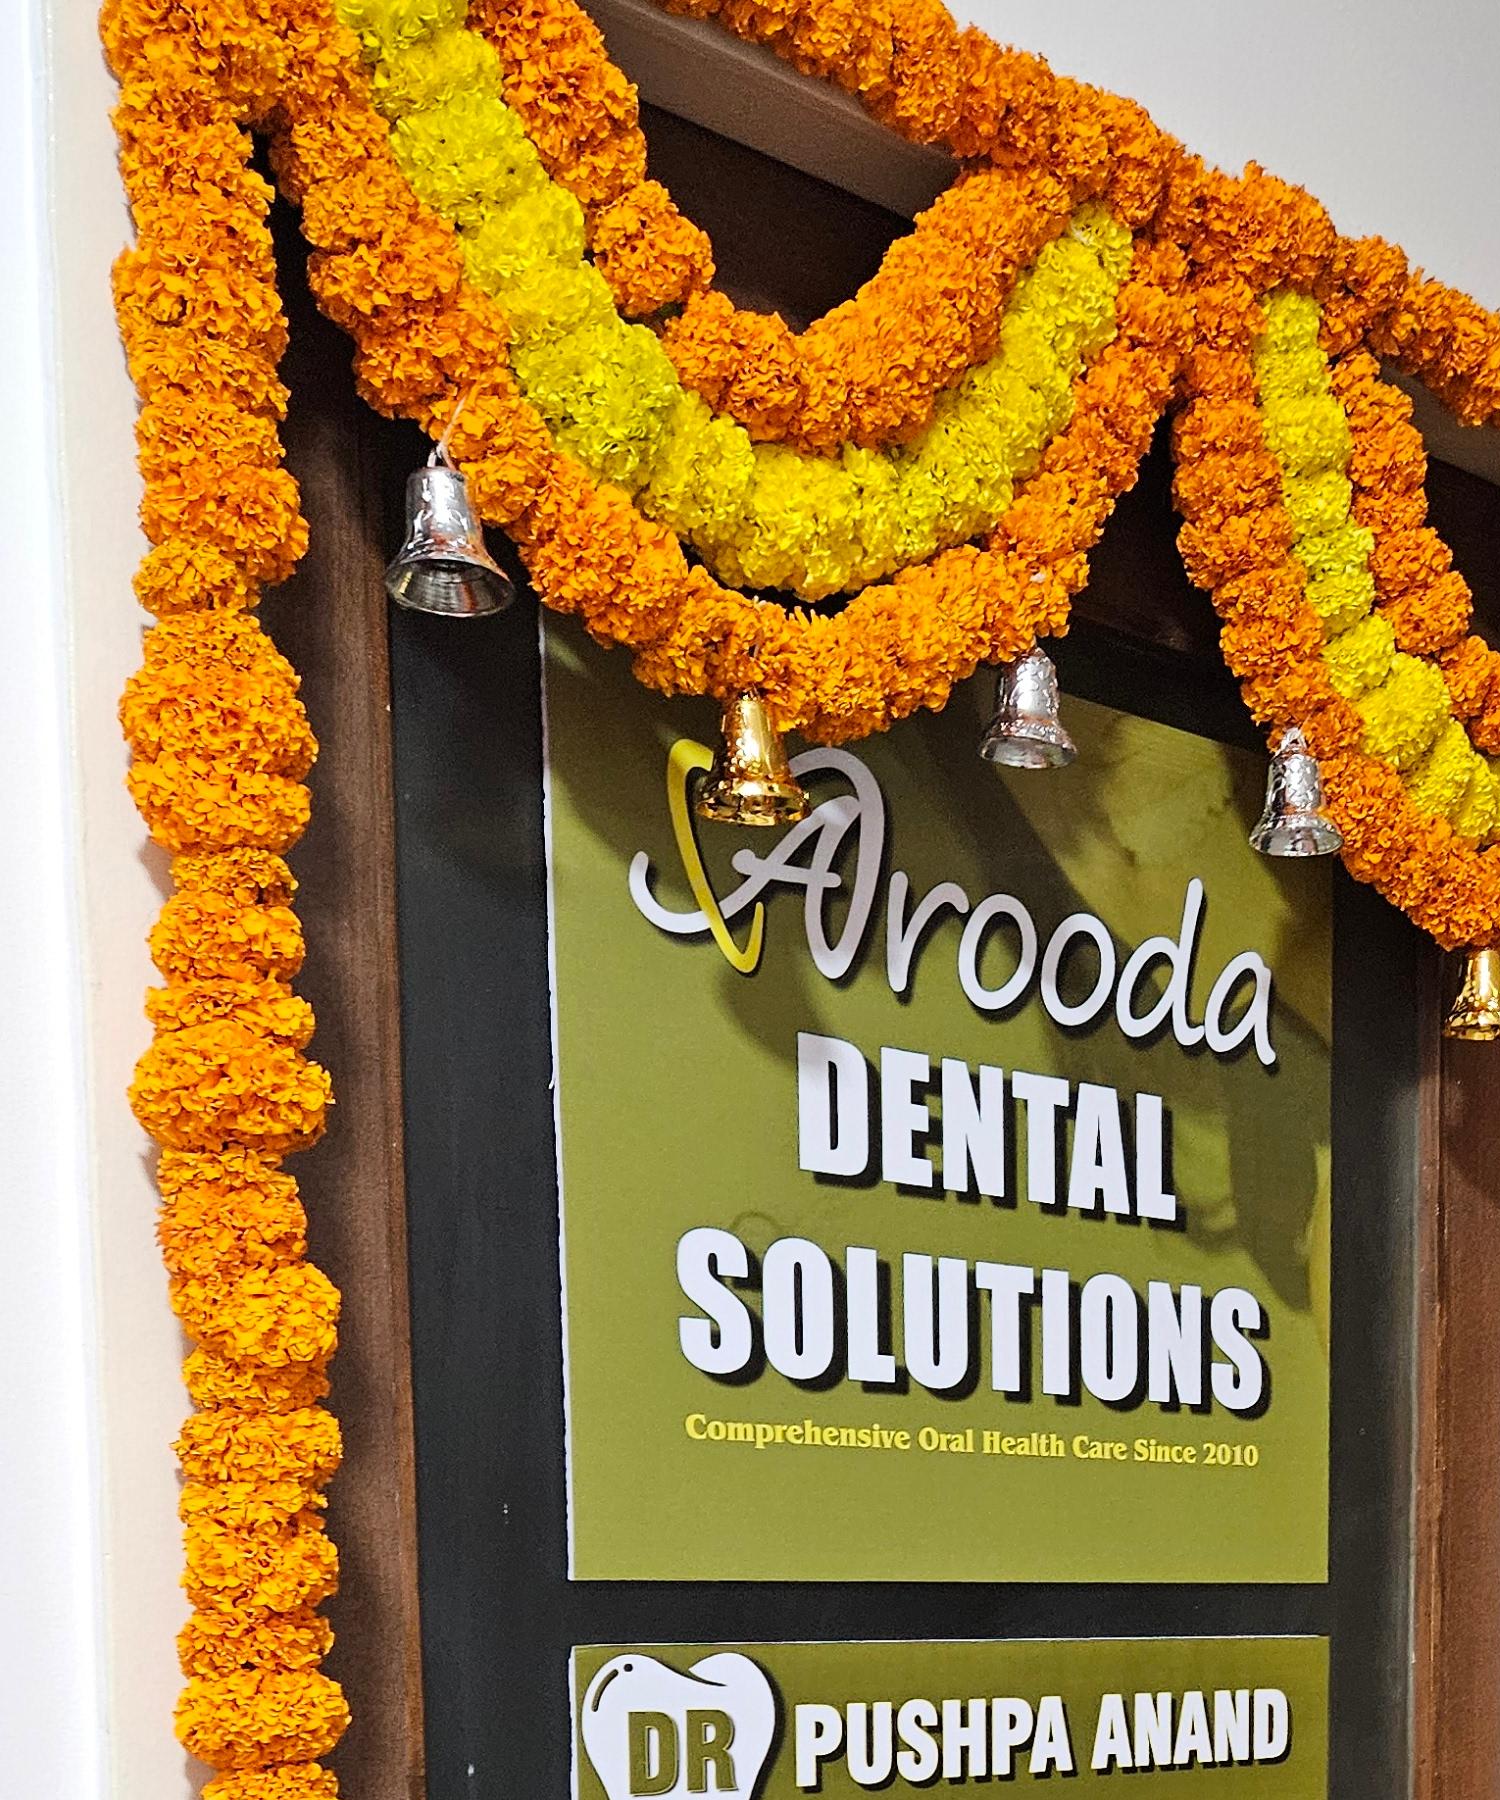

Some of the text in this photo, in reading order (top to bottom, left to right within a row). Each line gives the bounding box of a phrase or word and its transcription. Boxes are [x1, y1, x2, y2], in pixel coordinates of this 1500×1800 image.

[628, 738, 1278, 1067] Arooda
[797, 1032, 1177, 1222] DENTAL
[676, 1227, 1264, 1412] SOLUTIONS
[685, 1413, 1260, 1468] Comprehensive Oral Health Care Since 2010
[627, 1710, 737, 1797] DR
[795, 1688, 1291, 1788] PUSHPA ANAND
